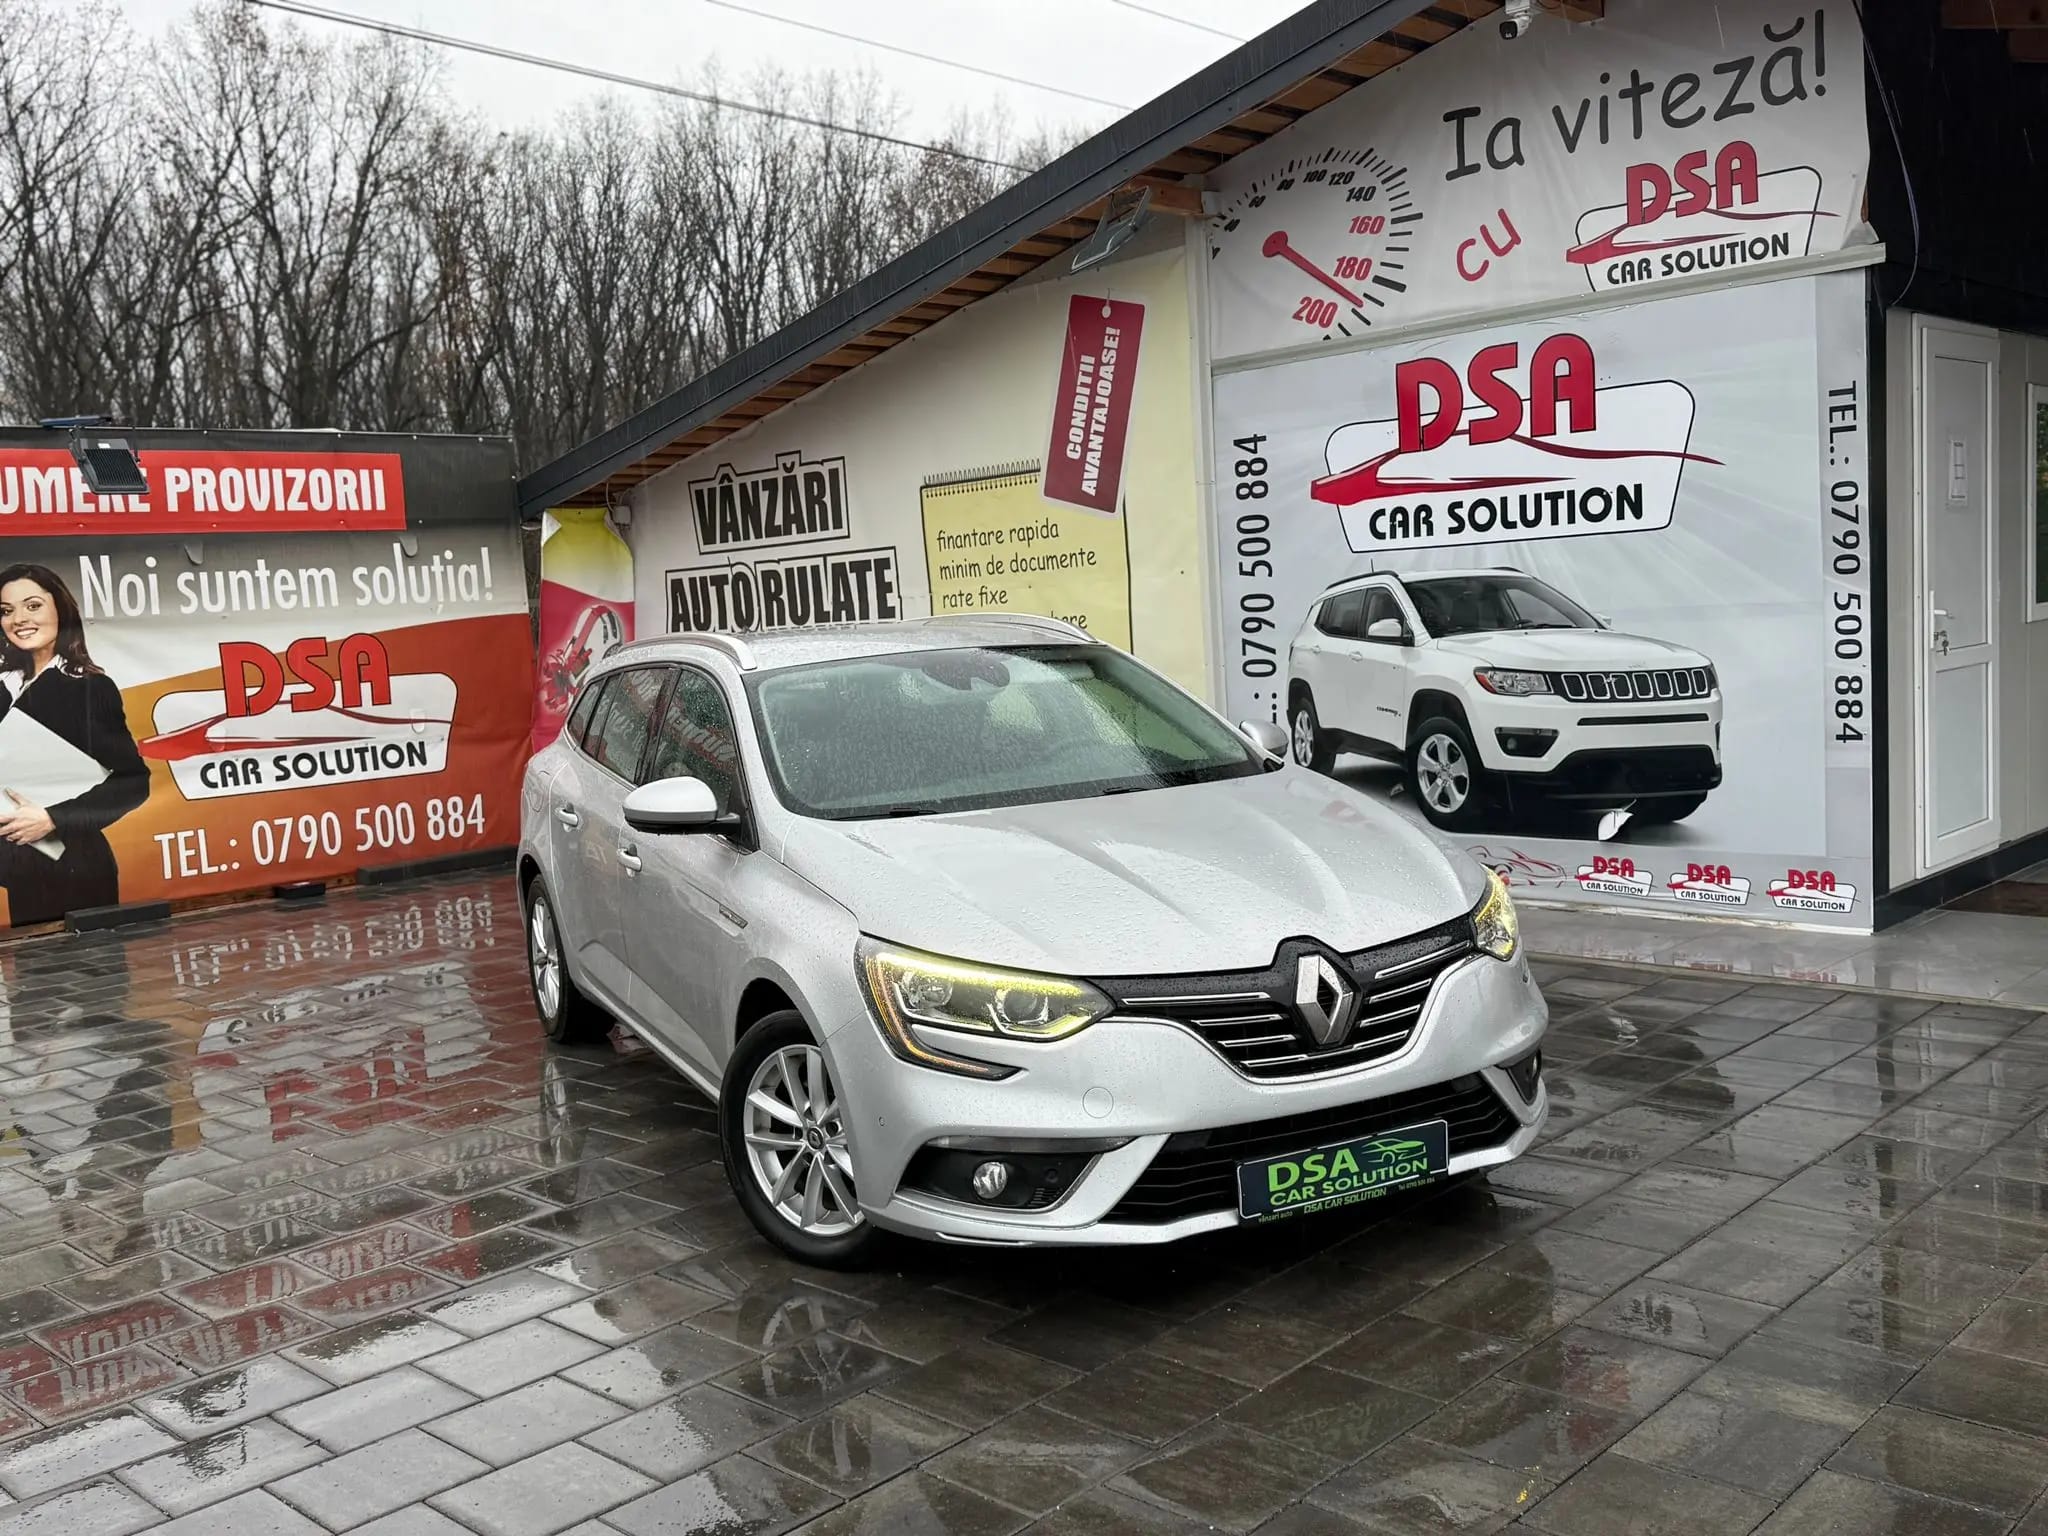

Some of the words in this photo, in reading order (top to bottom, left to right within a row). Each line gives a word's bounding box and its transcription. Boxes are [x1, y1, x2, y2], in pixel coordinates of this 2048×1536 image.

[1442, 106, 1525, 181] Ia
[1552, 9, 1827, 153] viteză!
[1303, 169, 1327, 183] 100
[1328, 171, 1355, 186] 120
[1346, 186, 1376, 202] 140
[1625, 140, 1759, 226] DSA
[1349, 215, 1385, 234] 160
[1457, 208, 1522, 282] cu
[1333, 256, 1373, 281] 180
[1606, 257, 1653, 285] CAR
[1662, 232, 1790, 277] SOLUTION
[1292, 296, 1338, 328] 200
[1066, 354, 1096, 460] CONDITII
[1081, 326, 1121, 497] AVANTAJOASE!
[1395, 333, 1597, 453] DSA
[164, 467, 386, 513] PROVIZORII
[1233, 434, 1269, 500] 884
[694, 461, 844, 546] VÂNZĂRI
[1368, 500, 1434, 541] CAR
[1447, 483, 1644, 534] SOLUTION
[1830, 480, 1861, 576] 0790
[937, 529, 1005, 552] finantare
[1009, 517, 1059, 547] rapida
[1236, 514, 1273, 578] 500
[79, 555, 161, 618] Noi
[177, 559, 339, 614] suntem
[352, 543, 494, 616] soluția!
[940, 558, 982, 580] minim
[986, 554, 1005, 576] de
[1009, 548, 1097, 574] documente
[670, 571, 756, 633] AUTO
[761, 557, 897, 628] RULATE
[942, 589, 974, 609] rate
[978, 585, 1008, 607] fixe
[1240, 593, 1277, 678] 0790
[1833, 591, 1863, 659] 500
[219, 633, 392, 718] DSA
[1834, 675, 1864, 744] 884
[200, 759, 262, 789] CAR
[273, 741, 428, 782] SOLUTION
[154, 827, 240, 879] TEL.:
[251, 810, 342, 866] 0790
[355, 801, 416, 852] 500
[426, 793, 486, 842] 884
[1586, 881, 1601, 890] CAR
[1602, 883, 1643, 895] SOLUTION
[1593, 856, 1635, 878] DSA
[1687, 863, 1732, 886] DSA
[1787, 869, 1836, 892] DSA
[1680, 890, 1697, 900] CAR
[1699, 891, 1741, 904] SOLUTION
[1780, 897, 1798, 907] CAR
[1800, 899, 1846, 911] SOLUTION
[1267, 1148, 1360, 1193] DSA
[1270, 1184, 1316, 1207] CAR
[1322, 1157, 1428, 1195] SOLUTION
[1304, 1202, 1323, 1214] DSA
[1324, 1198, 1342, 1209] CAR
[1343, 1187, 1387, 1205] SOLUTION
